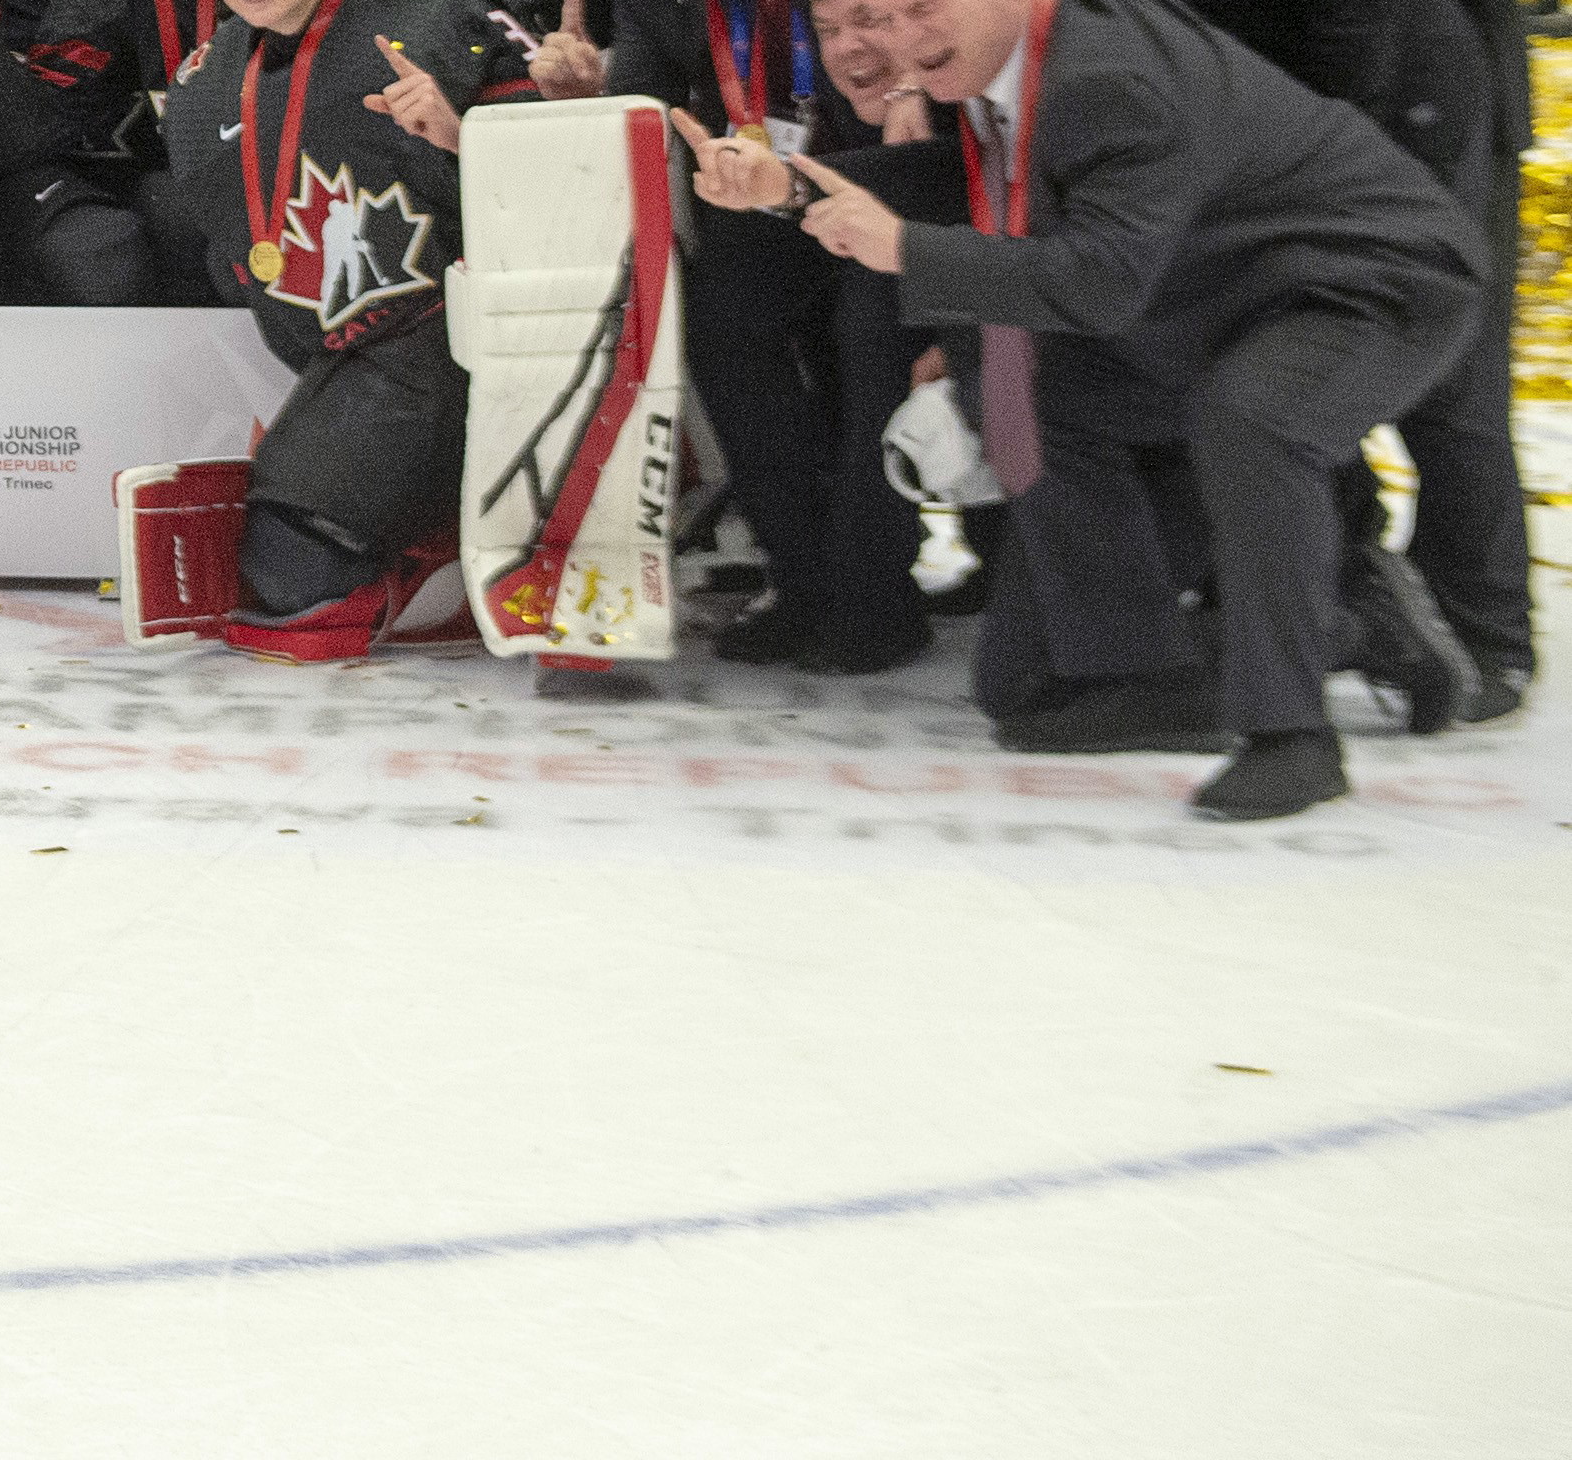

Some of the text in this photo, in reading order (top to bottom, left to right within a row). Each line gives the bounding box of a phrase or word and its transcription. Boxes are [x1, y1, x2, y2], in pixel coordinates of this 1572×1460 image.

[3, 425, 77, 440] JUNIOR
[637, 411, 672, 538] CCM
[5, 476, 53, 490] Trinec
